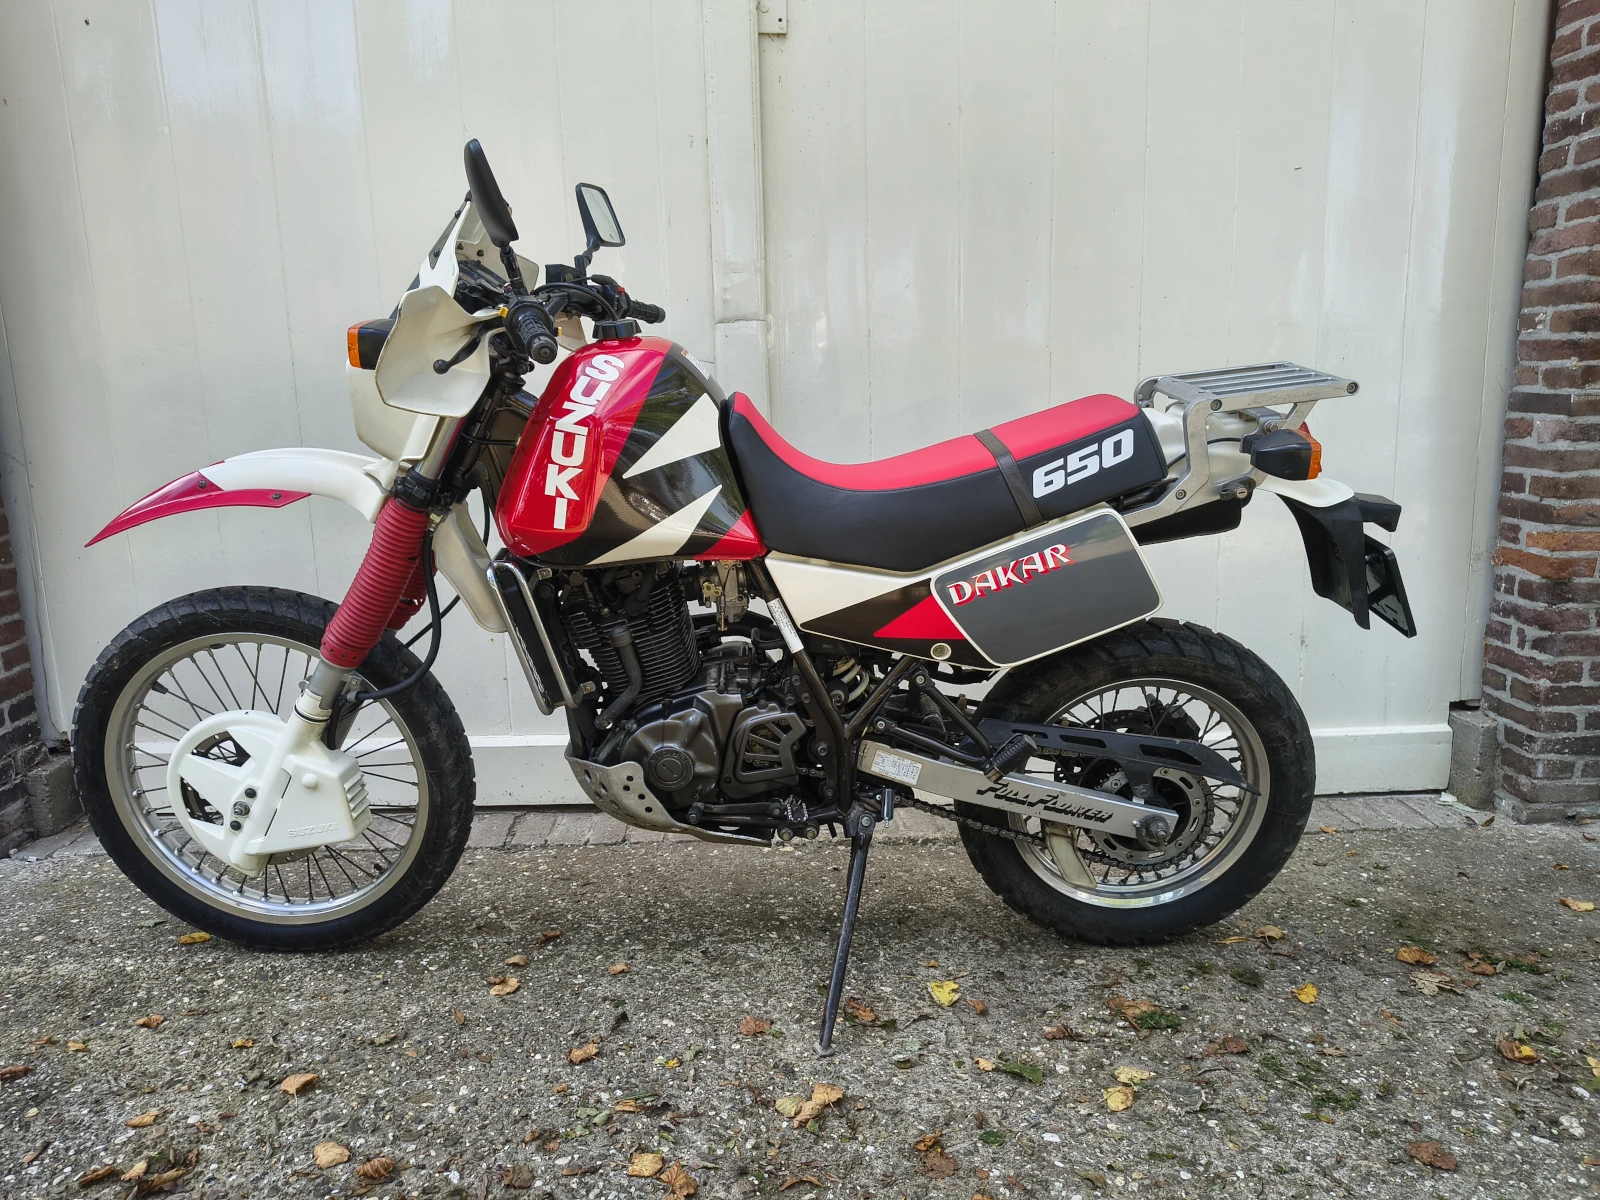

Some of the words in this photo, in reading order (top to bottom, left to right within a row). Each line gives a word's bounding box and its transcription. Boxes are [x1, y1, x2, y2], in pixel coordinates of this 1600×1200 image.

[545, 355, 625, 530] SUZUKI
[1032, 428, 1134, 495] 650
[946, 543, 1074, 605] DAKAR
[287, 822, 339, 838] SUZUKI
